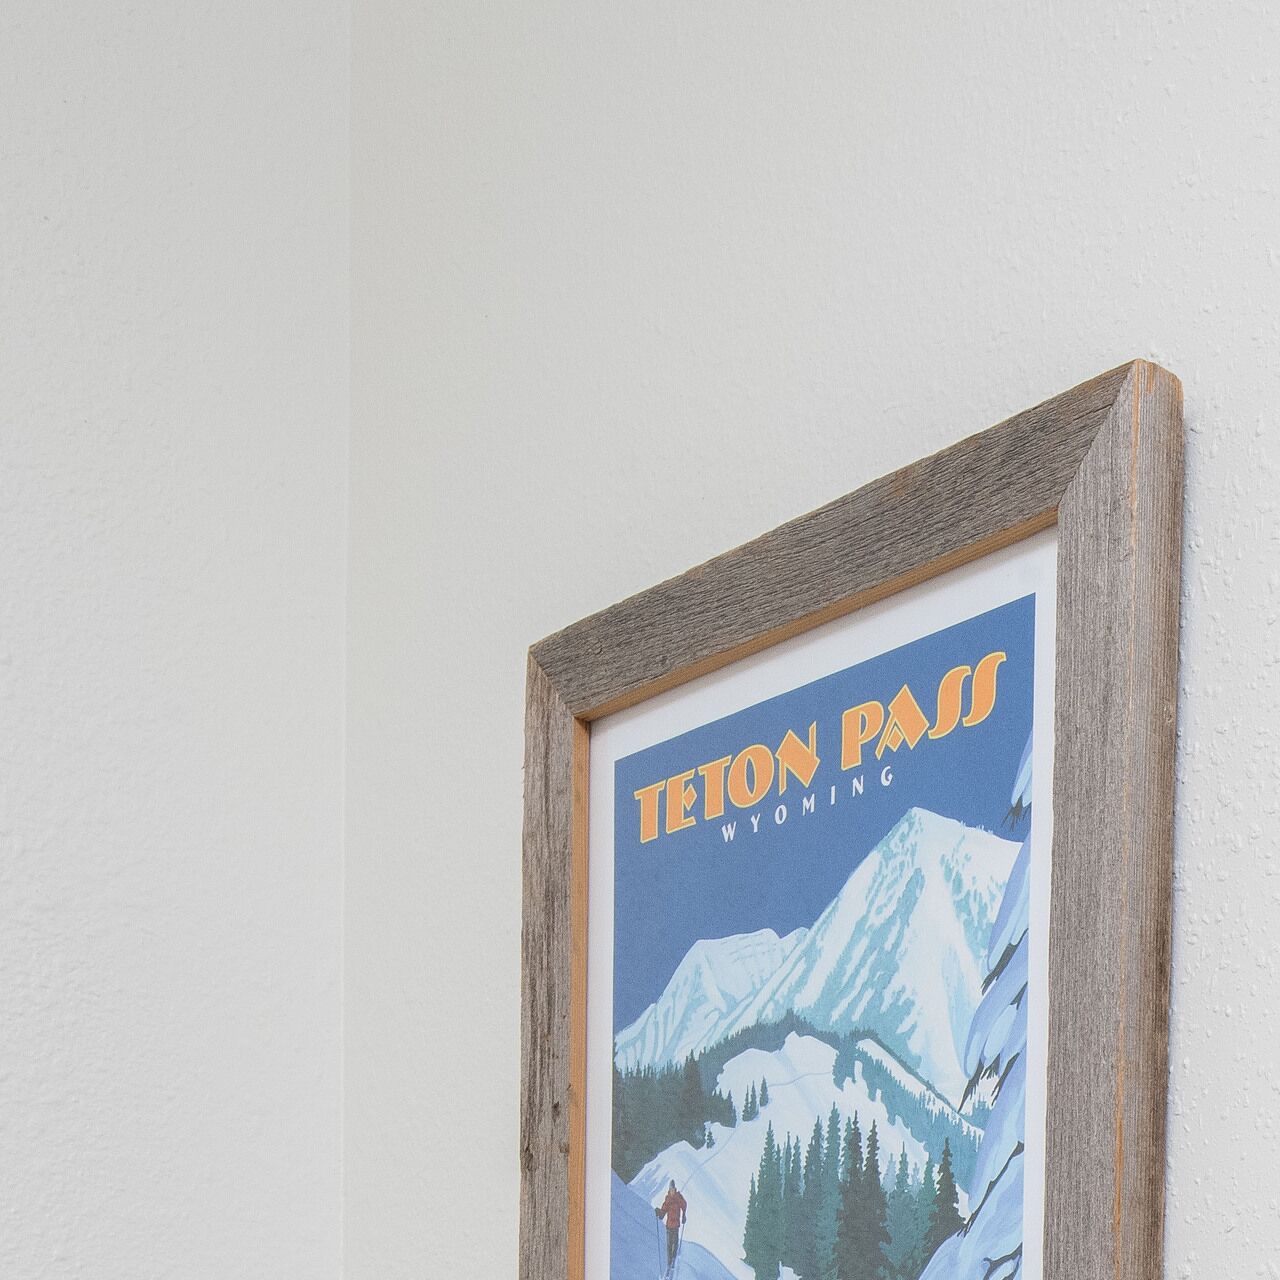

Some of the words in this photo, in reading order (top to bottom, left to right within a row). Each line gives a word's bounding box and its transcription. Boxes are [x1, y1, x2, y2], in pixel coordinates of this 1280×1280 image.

[633, 720, 821, 844] TETON
[840, 651, 1007, 771] PASS
[720, 765, 894, 843] WYOMING
